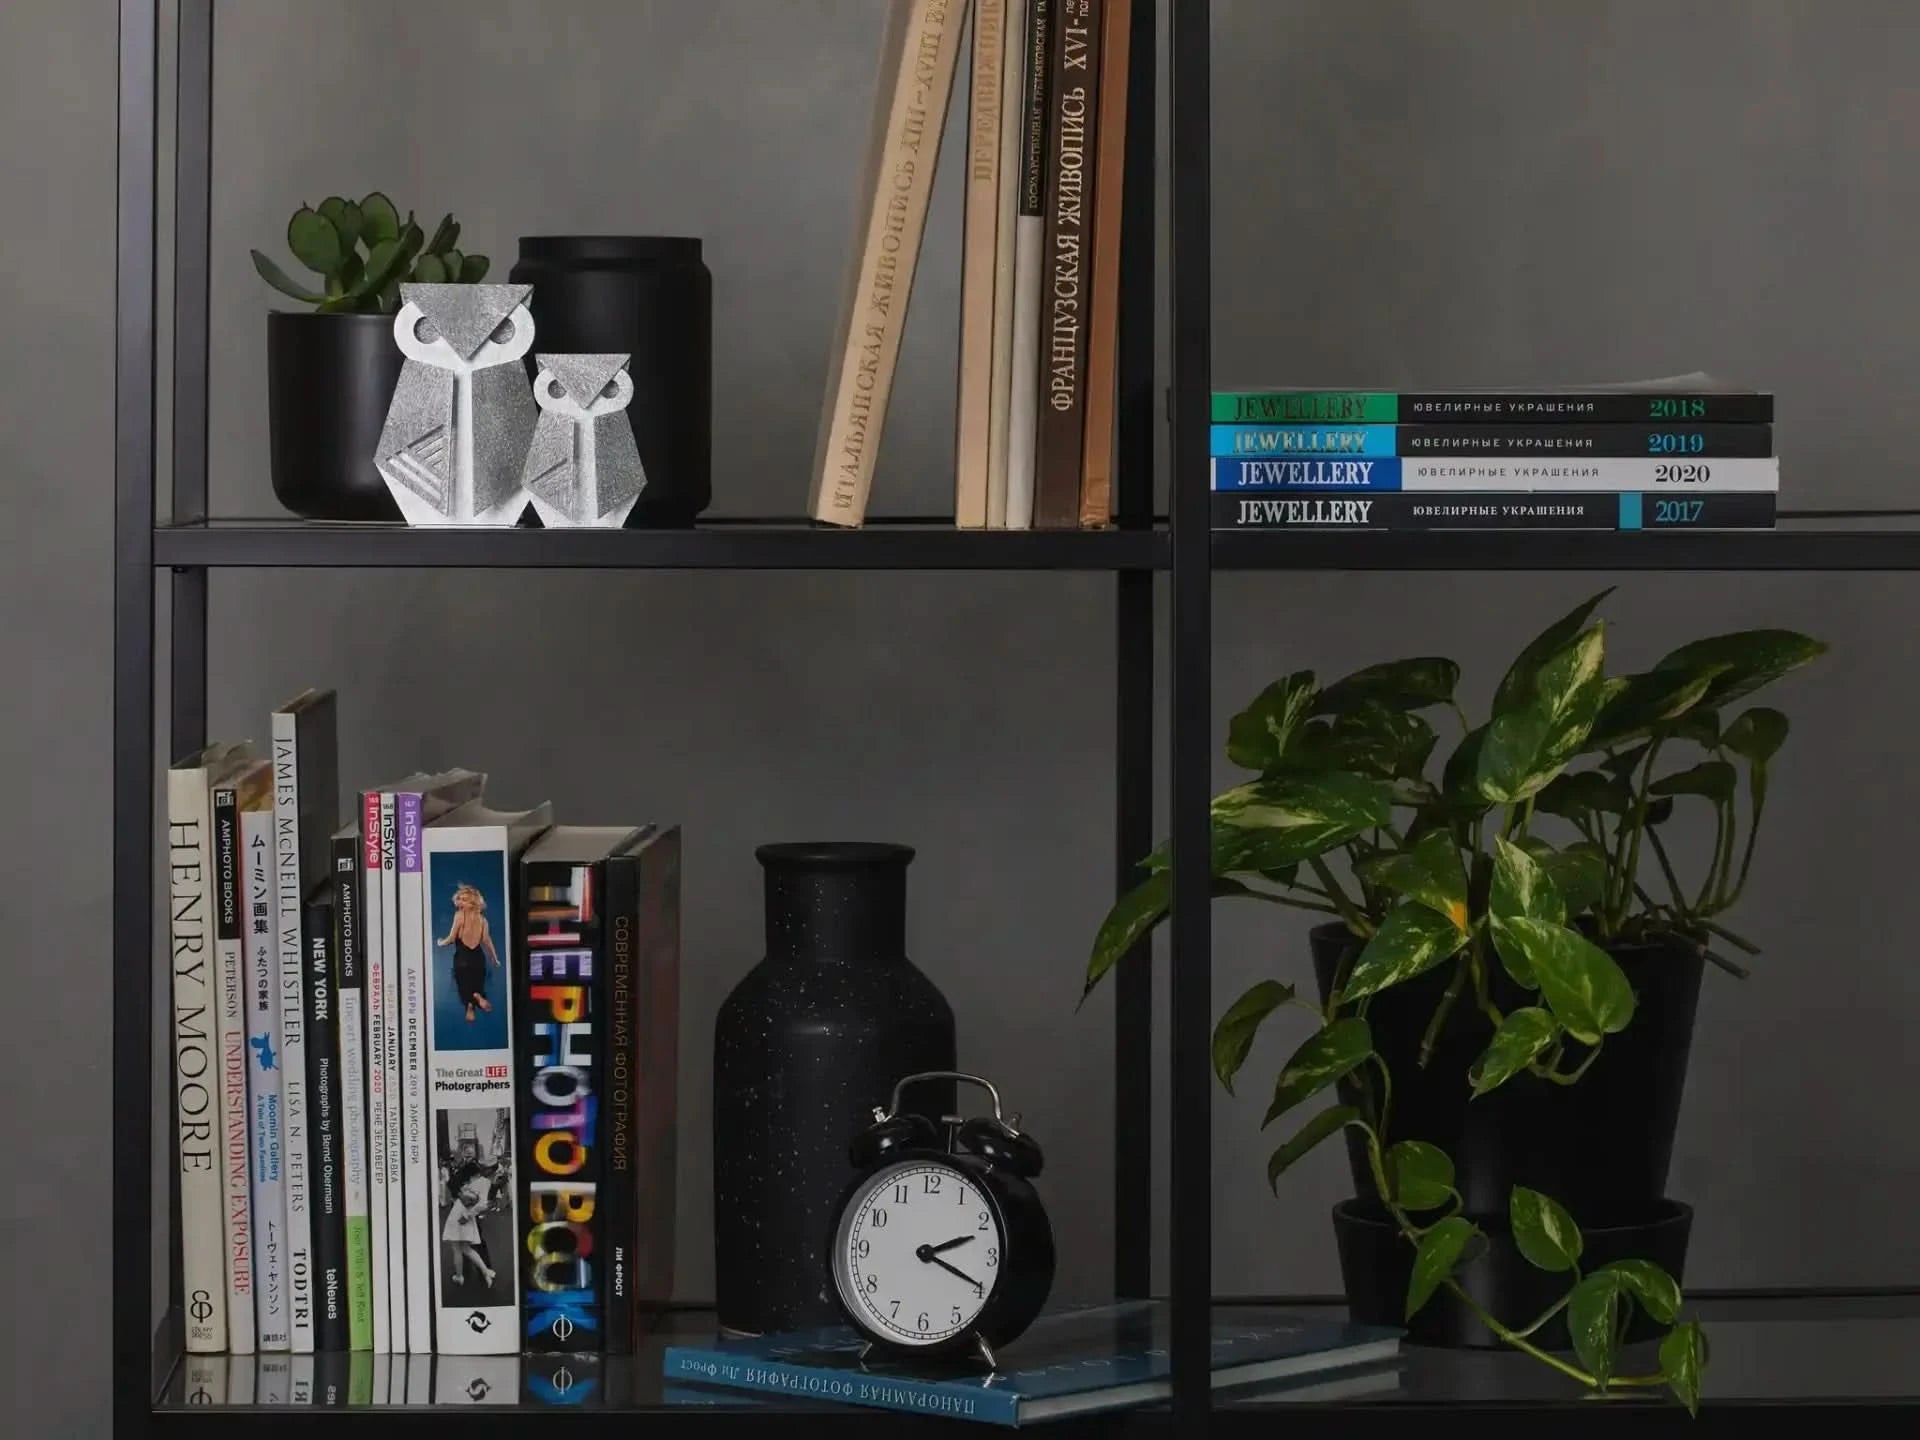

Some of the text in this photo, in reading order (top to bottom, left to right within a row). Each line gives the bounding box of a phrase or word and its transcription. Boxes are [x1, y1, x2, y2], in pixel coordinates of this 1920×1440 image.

[1058, 87, 1086, 225] ЖИВОПИСЬ
[835, 323, 885, 509] ИТАЛЬЯНСКАЯ
[871, 160, 915, 317] ЖИВОПИСЬ
[1050, 233, 1080, 411] ФРАНЦУЗСКАЯ
[1234, 397, 1368, 420] JEWELLERY
[1413, 403, 1594, 412] ЮВЕЛИРНЫЕ УКРАШЕНИЯ
[1649, 400, 1705, 417] 2018
[1233, 431, 1368, 453] JEWELLERY
[1411, 438, 1593, 448] ЮВЕЛИРНЫЕ УКРАШЕНИЯ
[1648, 434, 1704, 452] 2019
[1238, 462, 1374, 485] JEWELLERY
[1418, 467, 1599, 477] ЮВЕЛИРНЫЕ УКРАШЕНИЯ
[1655, 464, 1710, 482] 2020
[1237, 500, 1373, 524] JEWELLERY
[1413, 506, 1584, 516] ЮВЕЛИРНЫЕ УКРАШЕНИЯ
[1655, 501, 1704, 521] 2017
[366, 806, 380, 864] InStyle
[382, 813, 396, 871] InStyle
[403, 811, 417, 868] InStyle
[220, 819, 233, 924] AMPHOTO BOOKS
[251, 834, 269, 934] ムーミン画集
[274, 738, 301, 1047] JAMES McNEILL WHISTLER
[343, 884, 353, 977] AMPHOTO BOOKS
[169, 818, 212, 1173] HENRY MOORE
[224, 952, 236, 1017] PETERSON
[313, 938, 328, 1021] NEW YORK
[387, 1027, 396, 1071] JANUARY
[613, 916, 629, 1170] СОВРЕМЕННАЯ ФОТОГРАФИЯ
[372, 961, 384, 1184] ФЕВРАЛЬ FEBRUARY 2020 РЕНЕ ЗЕЛЛВЕГЕР
[407, 968, 419, 1164] ДЕКАБРЬ DECEMBER 2019 ЭЛИСОН БРИ
[435, 1066, 507, 1078] The Great LIFE
[435, 1080, 511, 1092] Photographers
[268, 1094, 280, 1181] Moomin Gallery
[319, 1058, 333, 1214] Photographs by Bernd Obermann
[389, 1106, 398, 1148] ТАТЬЯНА
[288, 1082, 304, 1214] LISA N. PETERS
[346, 1105, 364, 1185] photography
[224, 1031, 250, 1295] UNDERSTANDING EXPOSURE
[390, 1150, 399, 1183] НАВКА
[894, 1185, 908, 1203] 11
[923, 1175, 940, 1194] 12
[958, 1187, 965, 1205] 1
[872, 1208, 887, 1227] 10
[978, 1212, 989, 1230] 2
[858, 1240, 870, 1258] 9
[986, 1248, 997, 1267] 3
[293, 1248, 309, 1328] TODTRI
[615, 1247, 623, 1297] ЛИ ФРОСТ
[866, 1274, 877, 1293] 8
[326, 1268, 337, 1320] teNeues
[972, 1281, 985, 1299] 4
[890, 1301, 901, 1318] 7
[918, 1313, 929, 1331] 6
[950, 1306, 961, 1325] 5
[746, 1367, 854, 1396] ФОТОГРАФИЯ
[861, 1383, 976, 1415] ПАНОРАМНАЯ
